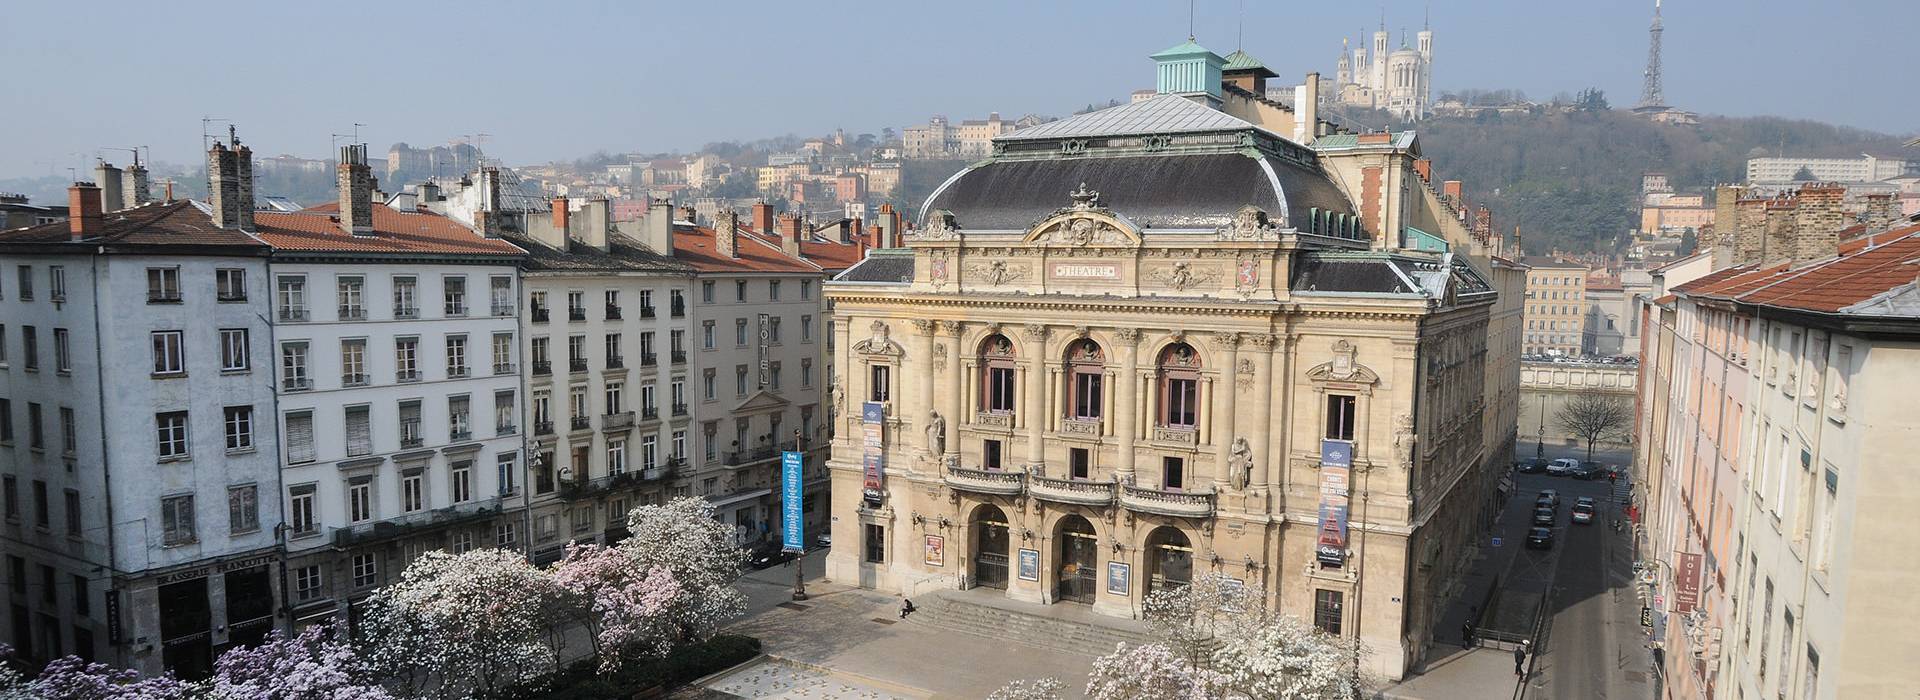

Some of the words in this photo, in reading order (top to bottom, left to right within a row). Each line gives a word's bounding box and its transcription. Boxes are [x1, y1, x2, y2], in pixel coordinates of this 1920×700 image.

[760, 314, 769, 385] HOTEL
[158, 567, 210, 584] BRASSERIE
[1686, 555, 1694, 590] HOTEL
